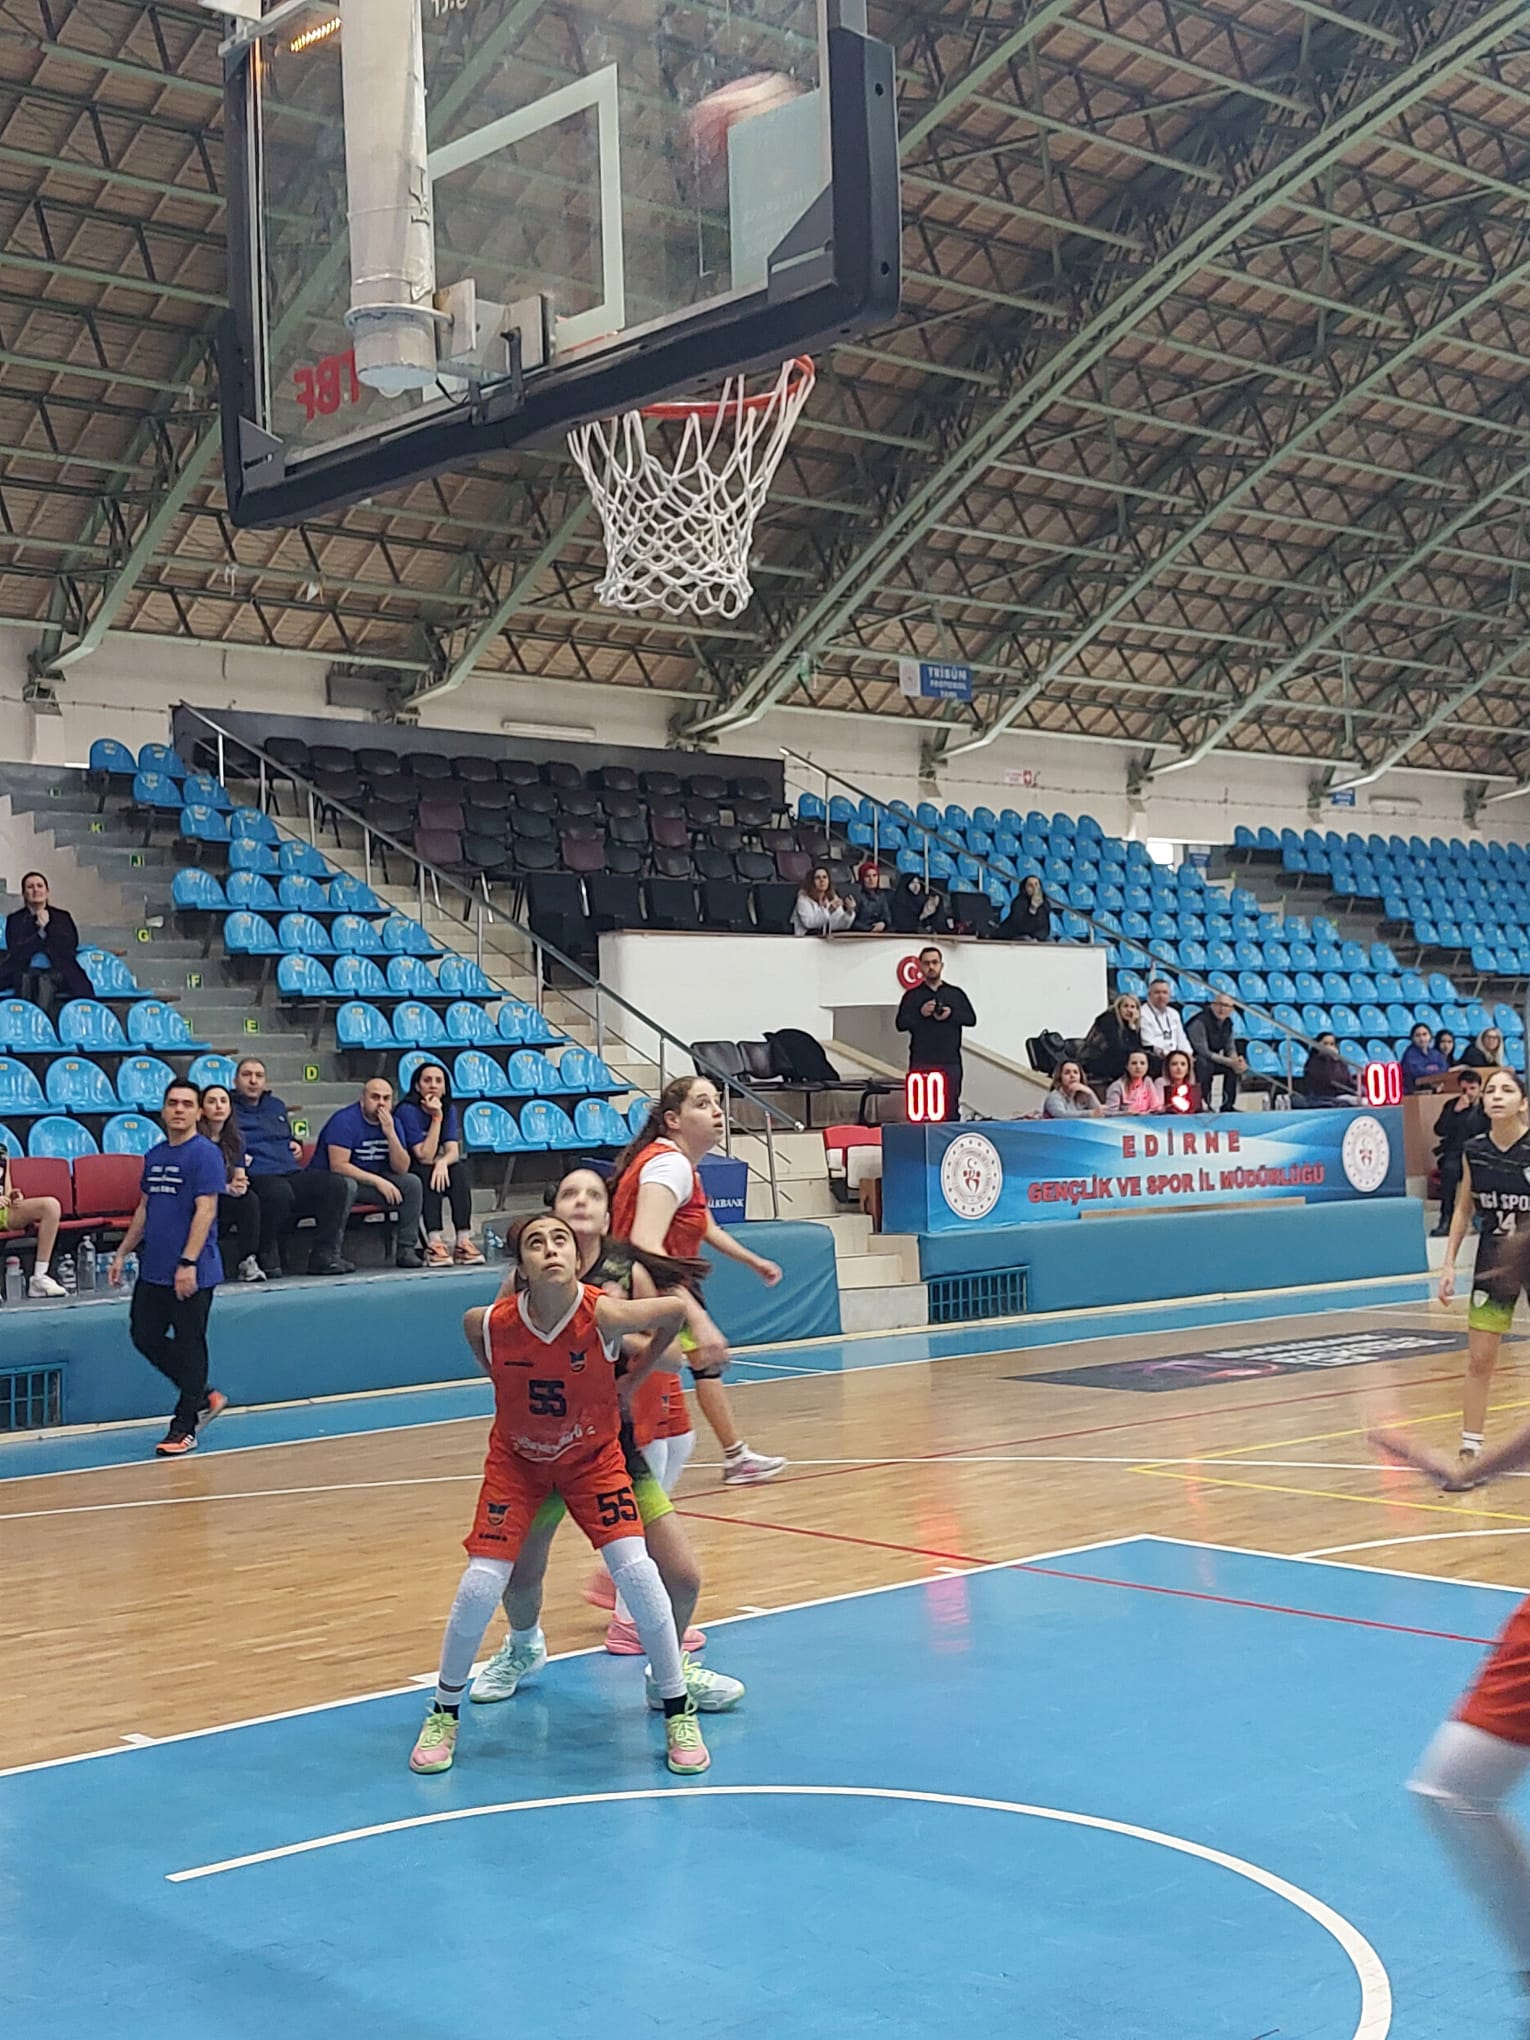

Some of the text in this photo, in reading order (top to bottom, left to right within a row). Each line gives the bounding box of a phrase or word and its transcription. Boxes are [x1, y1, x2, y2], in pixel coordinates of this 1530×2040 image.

[138, 929, 149, 941] G
[247, 1018, 257, 1032] E
[306, 1066, 318, 1080] D
[294, 1122, 306, 1135] C
[1028, 1174, 1113, 1205] GENÇLİK
[1117, 1176, 1142, 1197] VE
[1146, 1173, 1195, 1195] SPOR
[1500, 1193, 1530, 1211] SPO
[1492, 1210, 1517, 1236] 14
[529, 1379, 567, 1418] 55
[596, 1486, 638, 1526] 55
